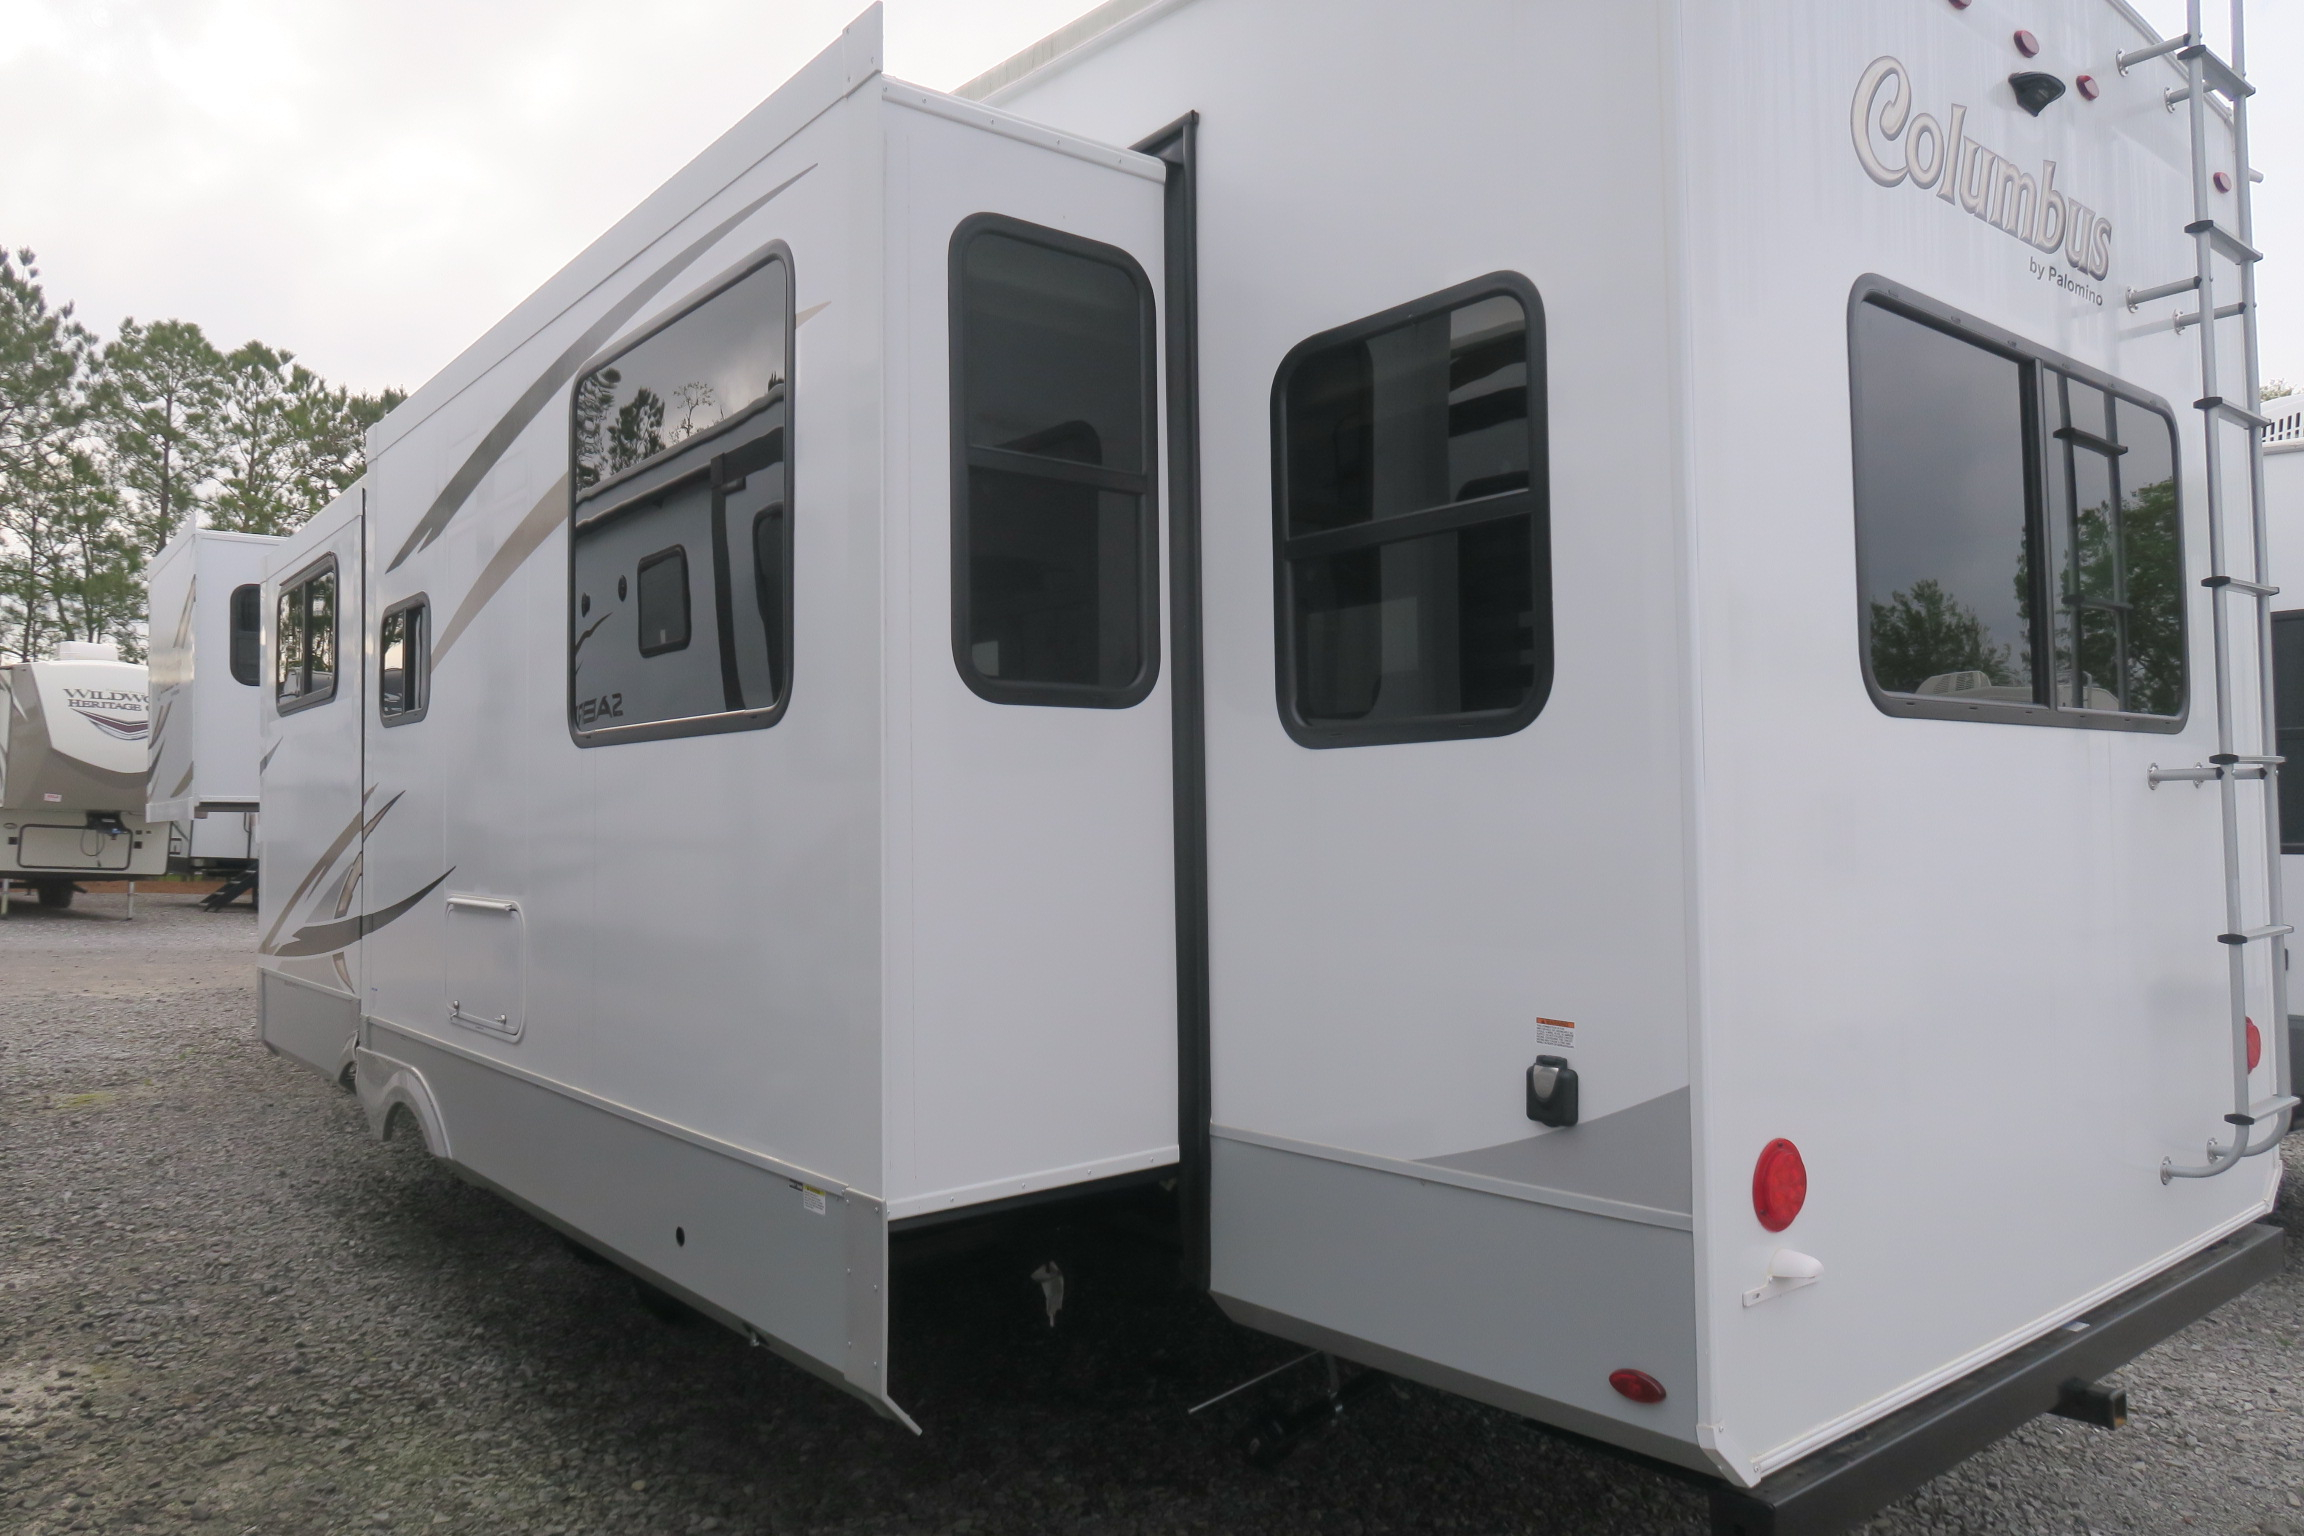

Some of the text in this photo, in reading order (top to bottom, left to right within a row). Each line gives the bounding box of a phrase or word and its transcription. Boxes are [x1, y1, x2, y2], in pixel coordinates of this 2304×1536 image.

[1850, 55, 2112, 281] Columbus
[2030, 256, 2103, 306] by Palomino
[68, 698, 141, 711] HERITAGE
